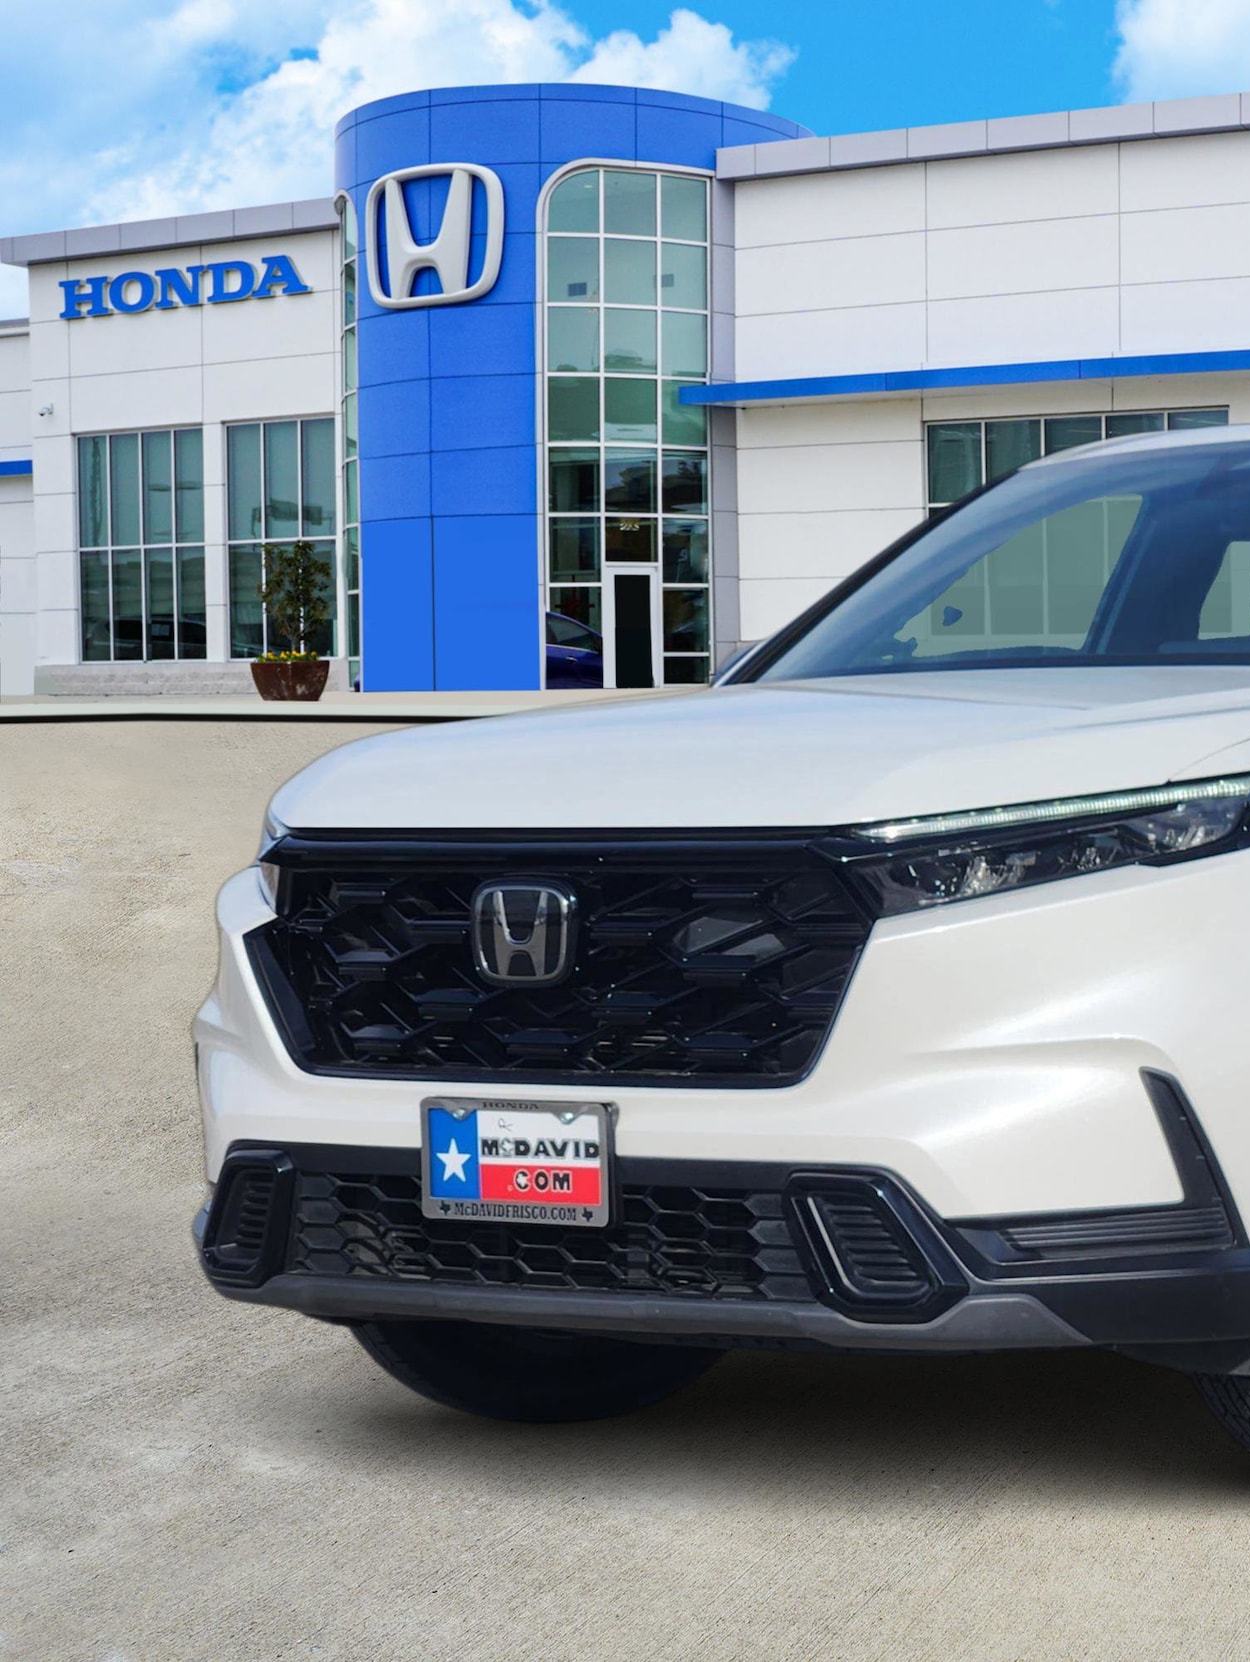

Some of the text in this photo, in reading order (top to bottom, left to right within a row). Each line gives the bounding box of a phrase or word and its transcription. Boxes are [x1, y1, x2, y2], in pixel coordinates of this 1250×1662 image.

[59, 255, 312, 320] HONDA
[482, 1101, 540, 1109] HONDA
[454, 1202, 577, 1221] McDAVIDFRISCO.COM
